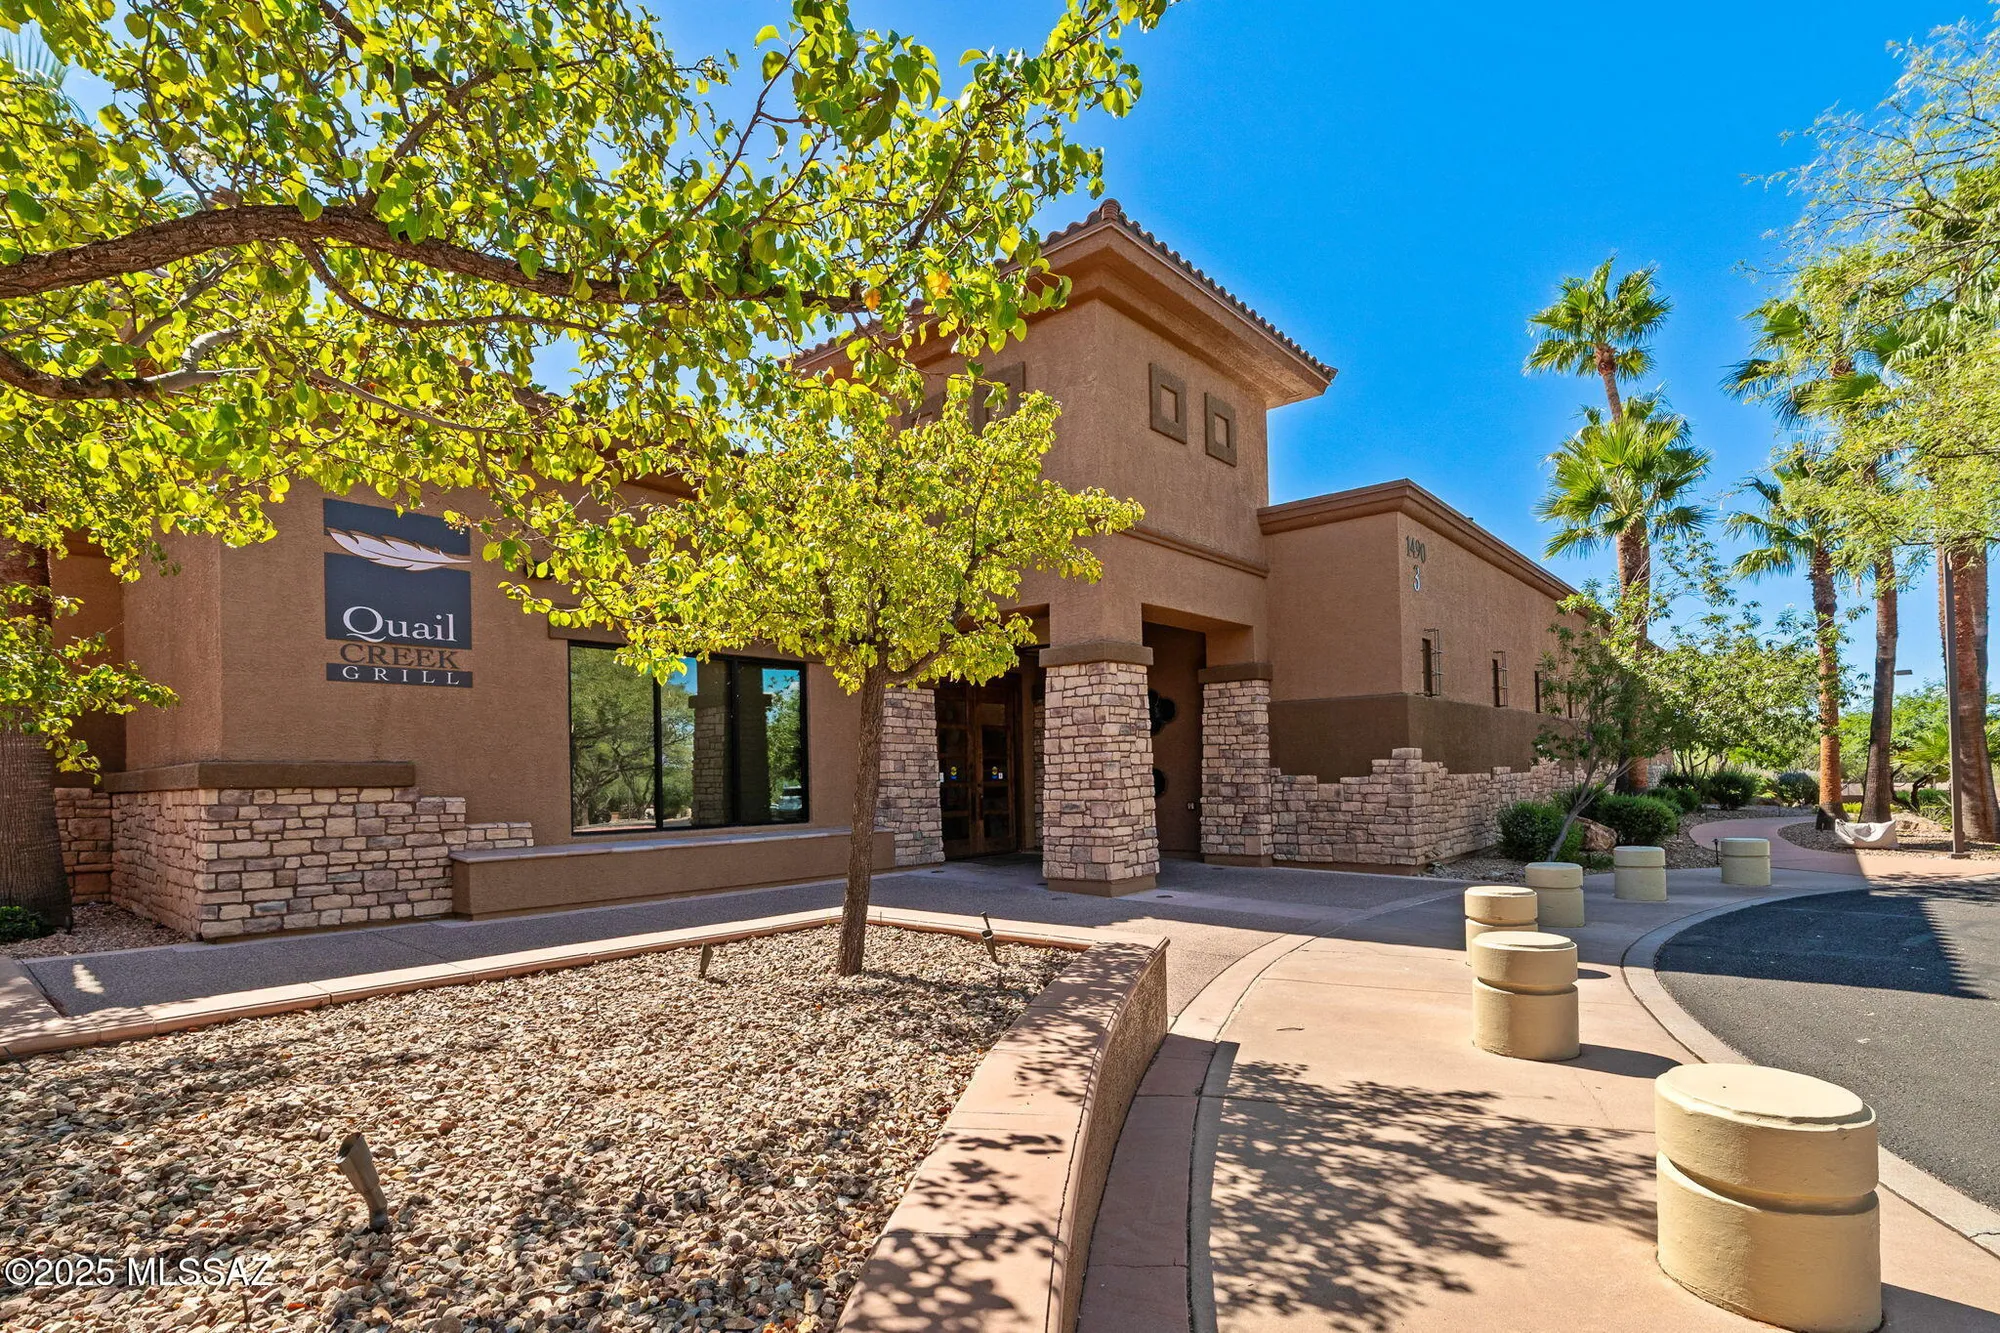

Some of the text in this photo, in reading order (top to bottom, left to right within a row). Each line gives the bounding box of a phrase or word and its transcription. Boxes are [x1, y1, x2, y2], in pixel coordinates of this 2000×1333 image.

[1406, 535, 1425, 563] 1490
[1412, 565, 1421, 592] 3
[342, 606, 457, 643] Quail
[340, 643, 460, 669] CREEK
[342, 666, 460, 685] GRILL
